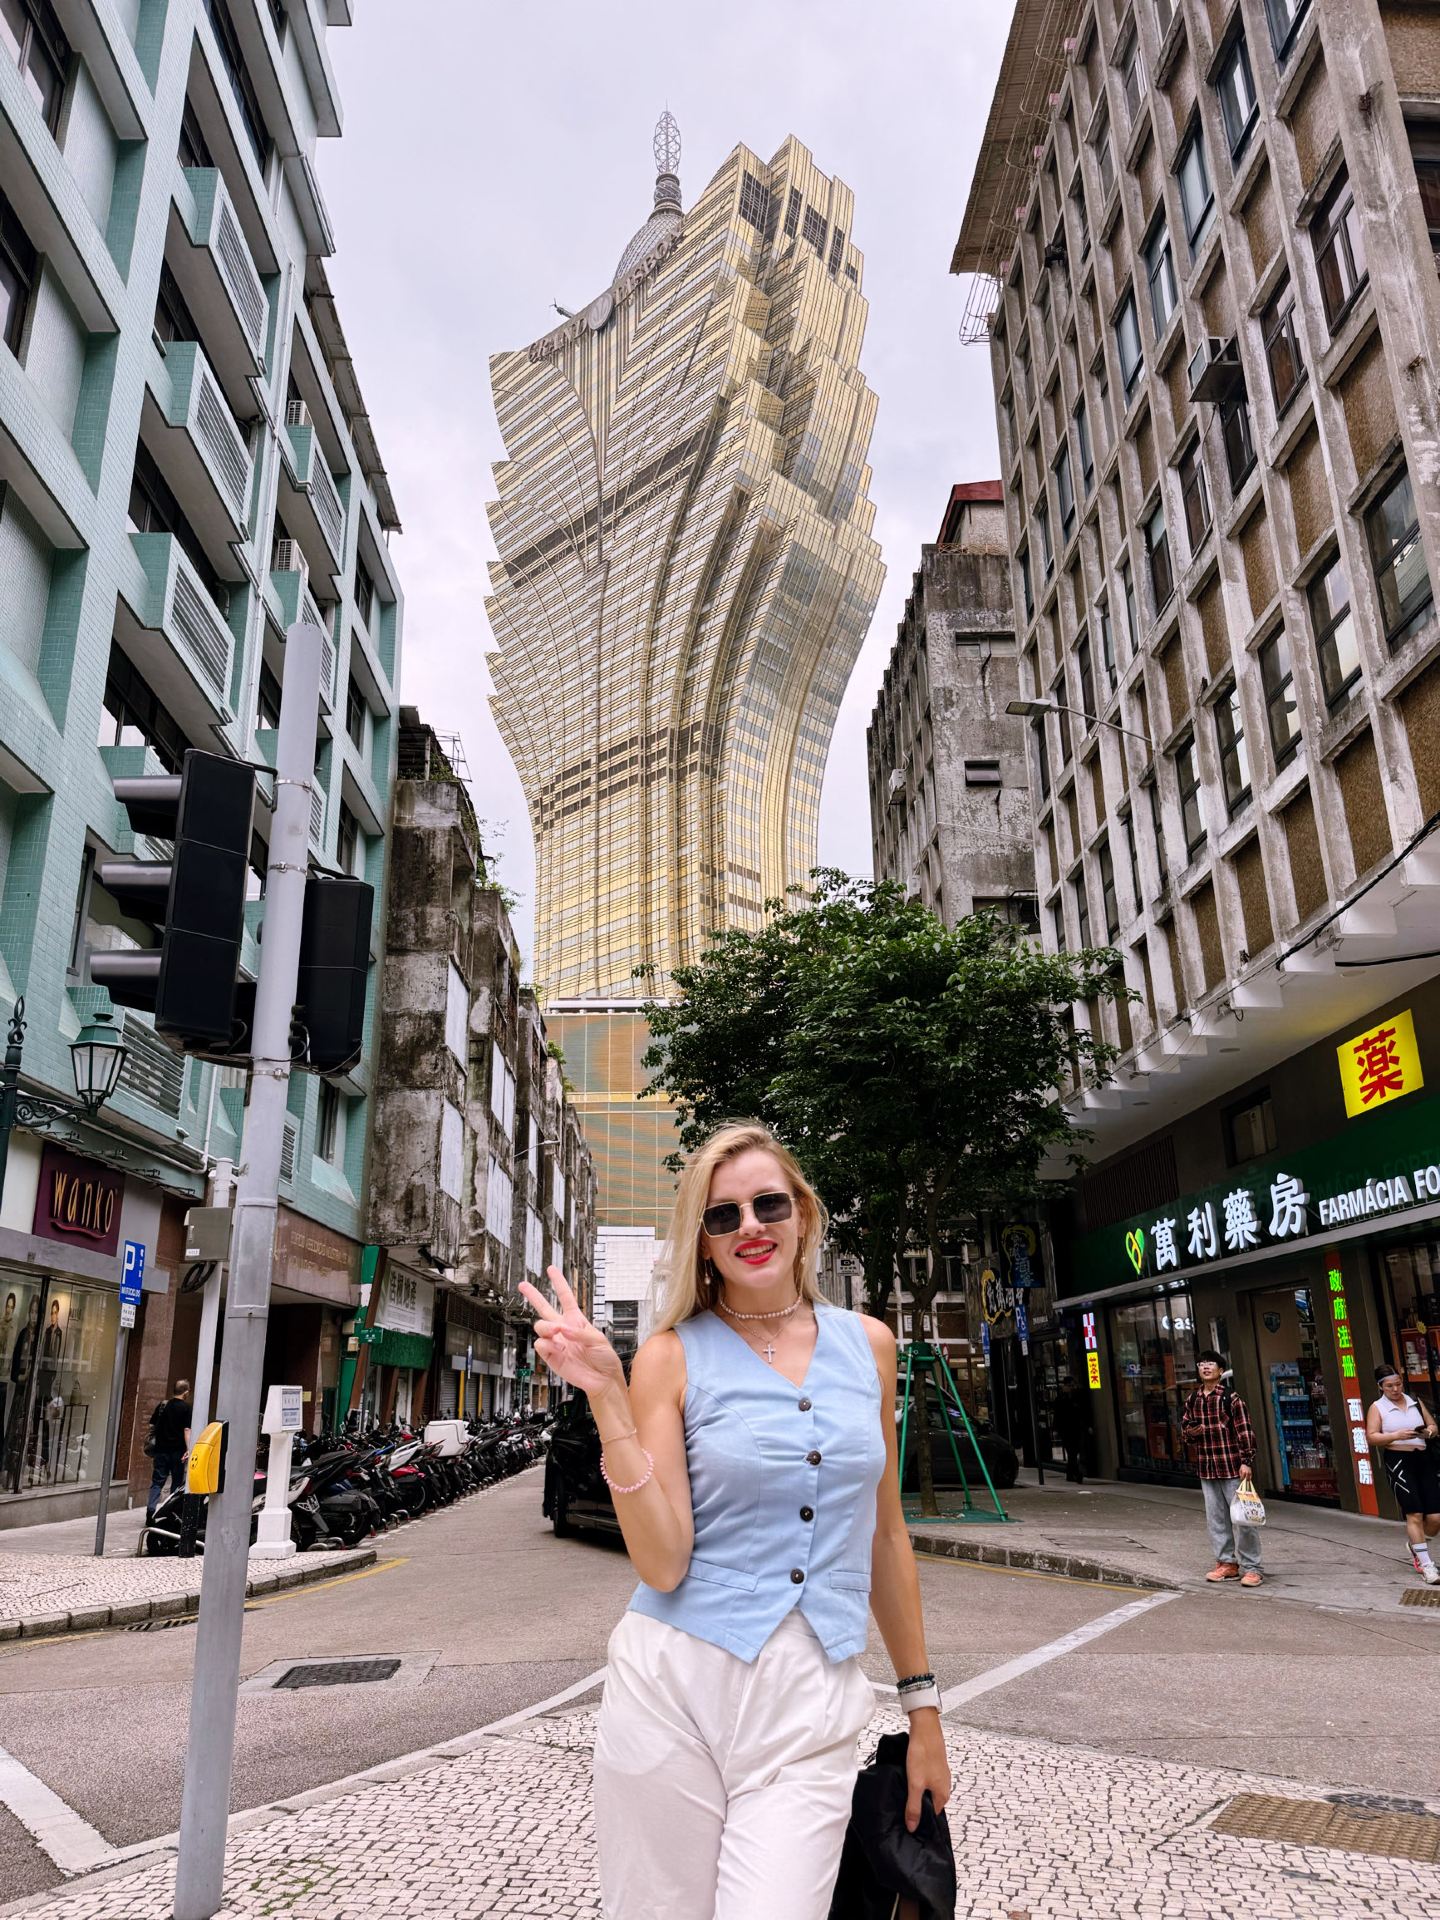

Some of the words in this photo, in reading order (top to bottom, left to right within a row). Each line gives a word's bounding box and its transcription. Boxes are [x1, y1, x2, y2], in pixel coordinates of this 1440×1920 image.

[1150, 1173, 1307, 1271] 萬利藥房
[1318, 1175, 1411, 1226] FARMÁCIA
[1413, 1164, 1440, 1199] FO
[122, 1244, 136, 1285] P
